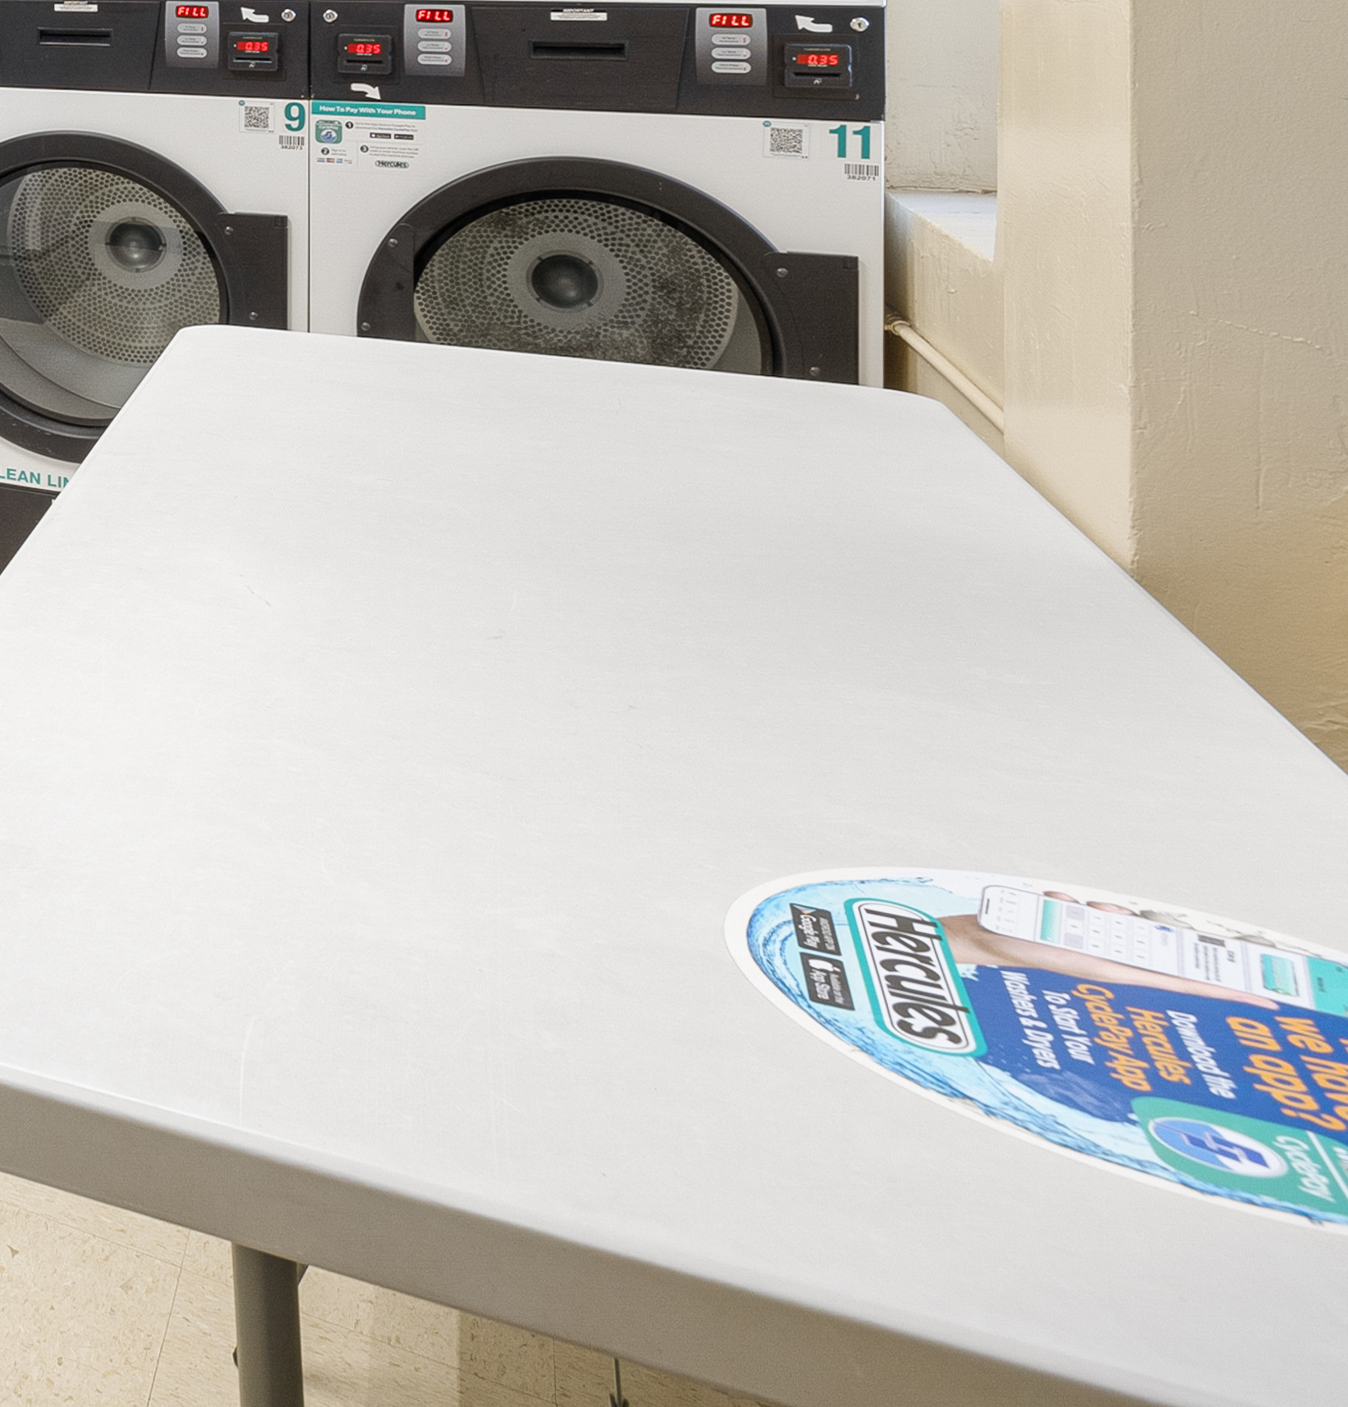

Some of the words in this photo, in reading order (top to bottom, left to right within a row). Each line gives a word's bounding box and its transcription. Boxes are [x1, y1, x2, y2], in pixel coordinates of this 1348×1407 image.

[177, 6, 207, 18] FILL
[417, 10, 451, 21] FILL
[711, 15, 750, 27] FILL
[284, 101, 306, 132] 9
[829, 124, 871, 160] 11
[864, 907, 972, 1049] Hercules
[1041, 988, 1072, 1004] To
[999, 969, 1040, 1019] Washers
[1022, 1026, 1062, 1071] Dryers
[1047, 1003, 1088, 1036] Start
[1070, 982, 1136, 1056] CyclePay
[1105, 1050, 1153, 1093] App
[1225, 1015, 1282, 1051] an
[1275, 1015, 1334, 1054] we
[1057, 1032, 1095, 1066] Your
[1124, 1005, 1193, 1086] Hercules
[1166, 1009, 1221, 1076] Download
[1201, 1073, 1238, 1100] the
[1243, 1054, 1347, 1132] app?
[1271, 1134, 1336, 1204] CyclePay
